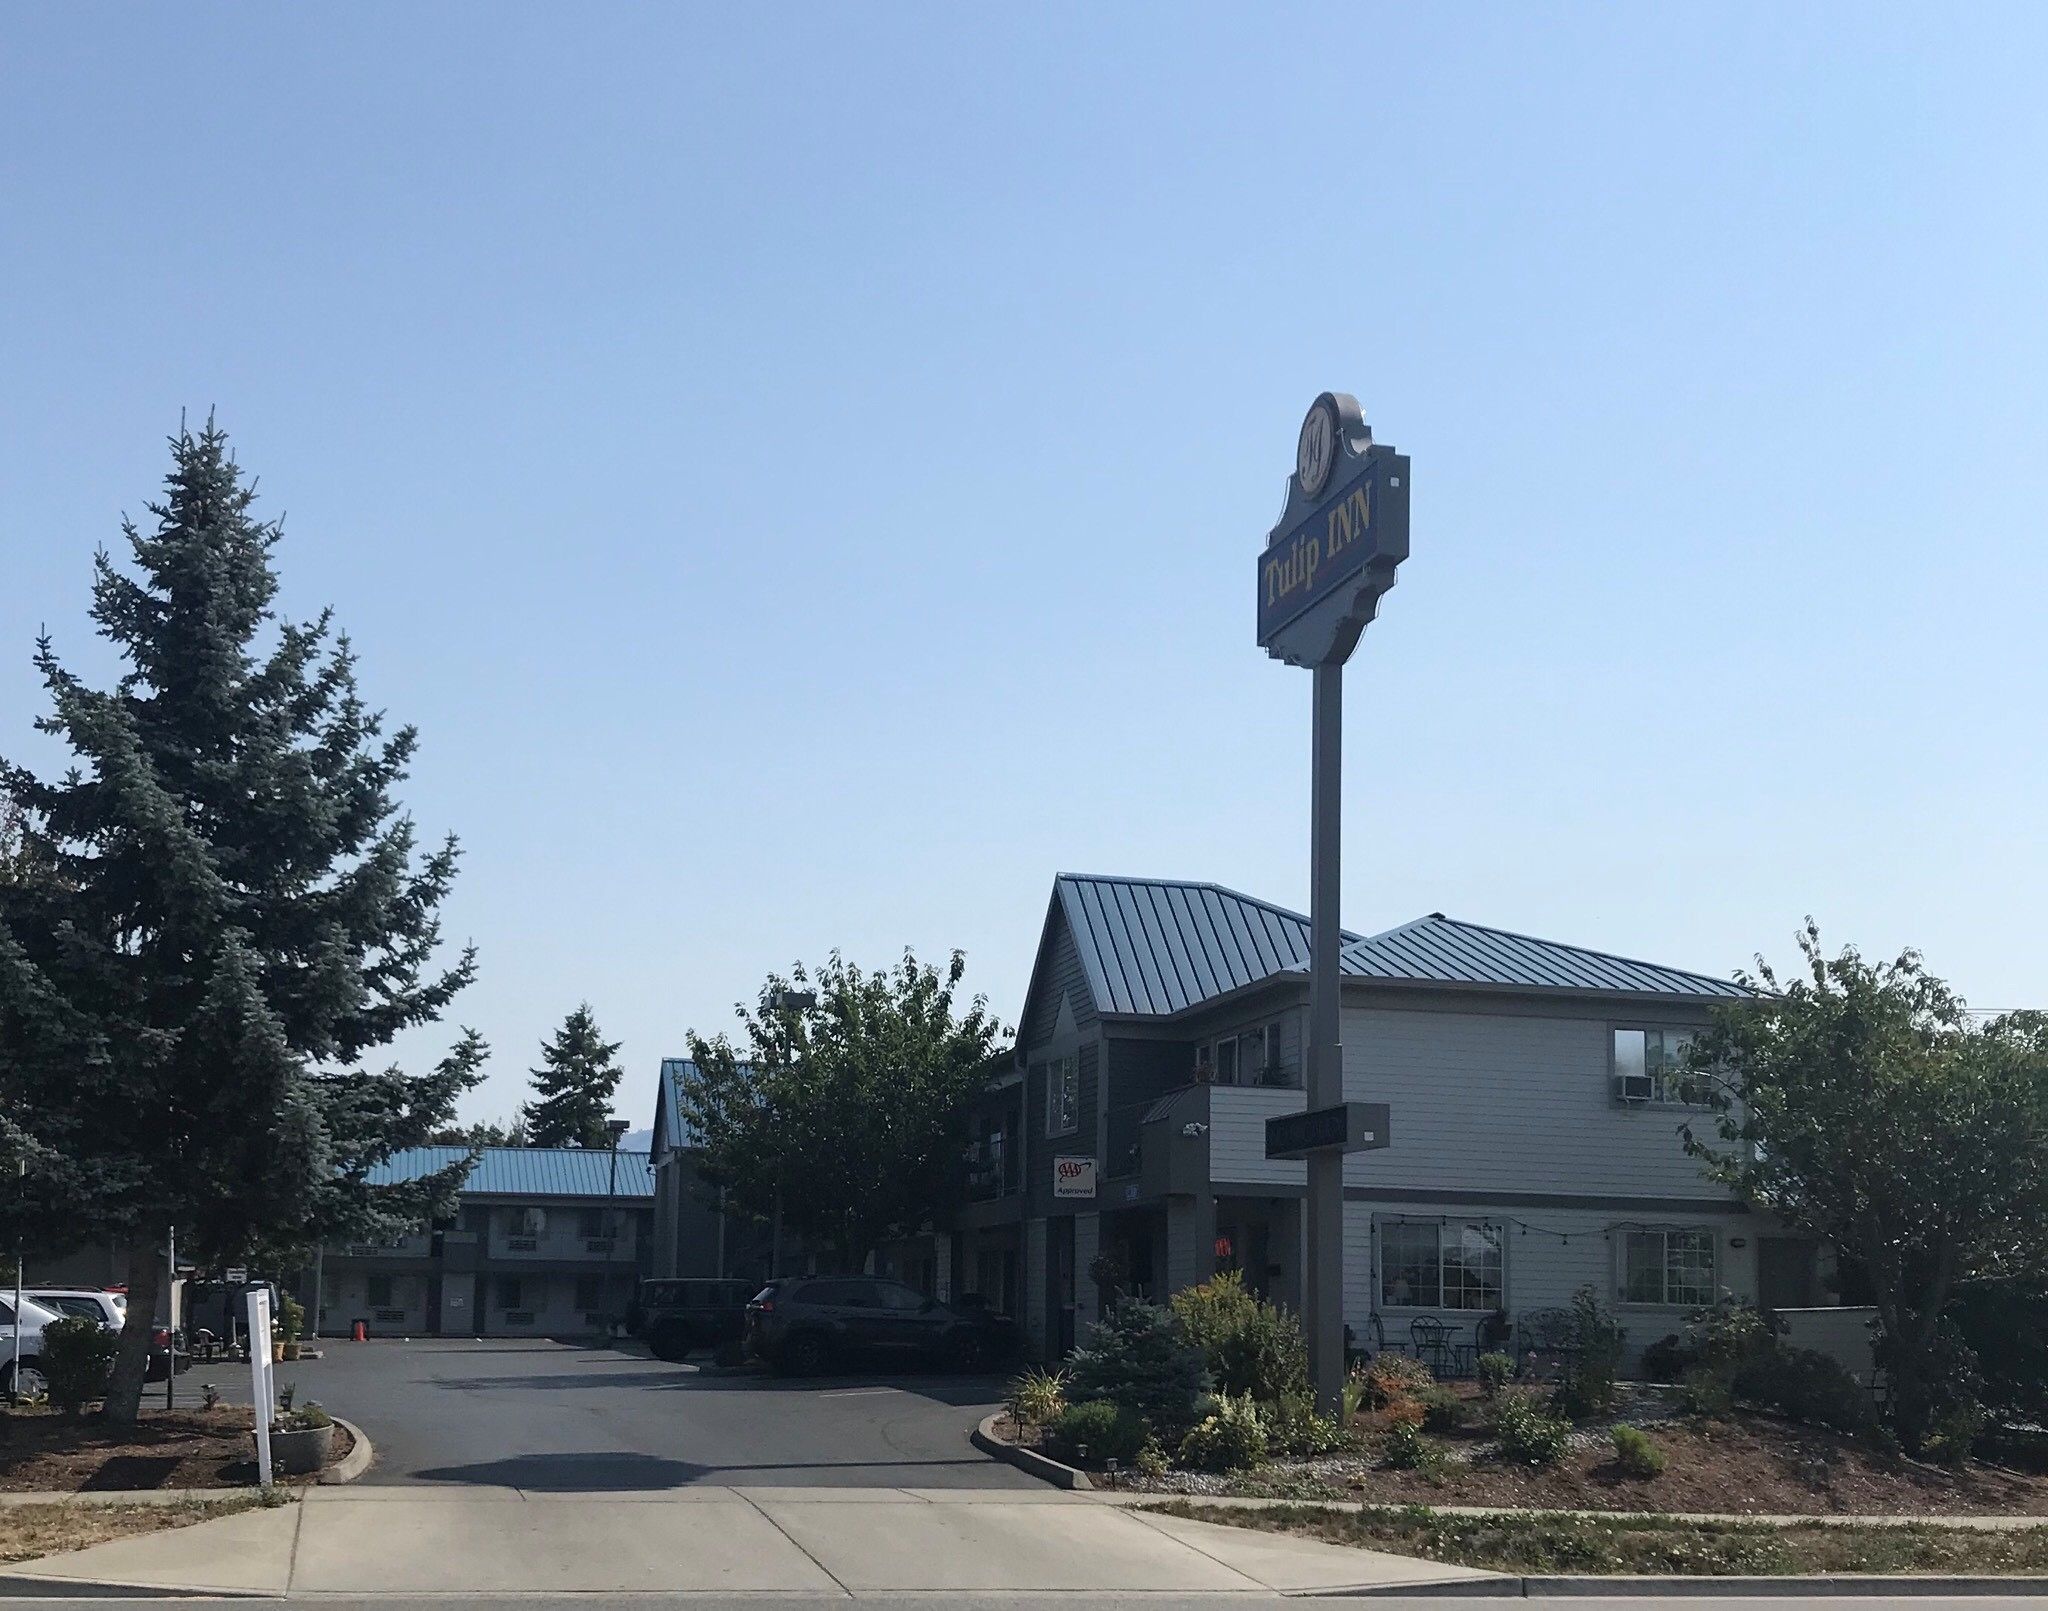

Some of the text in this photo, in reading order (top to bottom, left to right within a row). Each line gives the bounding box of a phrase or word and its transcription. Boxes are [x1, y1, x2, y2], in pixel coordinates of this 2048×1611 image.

[1265, 480, 1373, 608] Tulip INN
[1059, 1163, 1081, 1177] AAA
[1058, 1187, 1094, 1195] Approved
